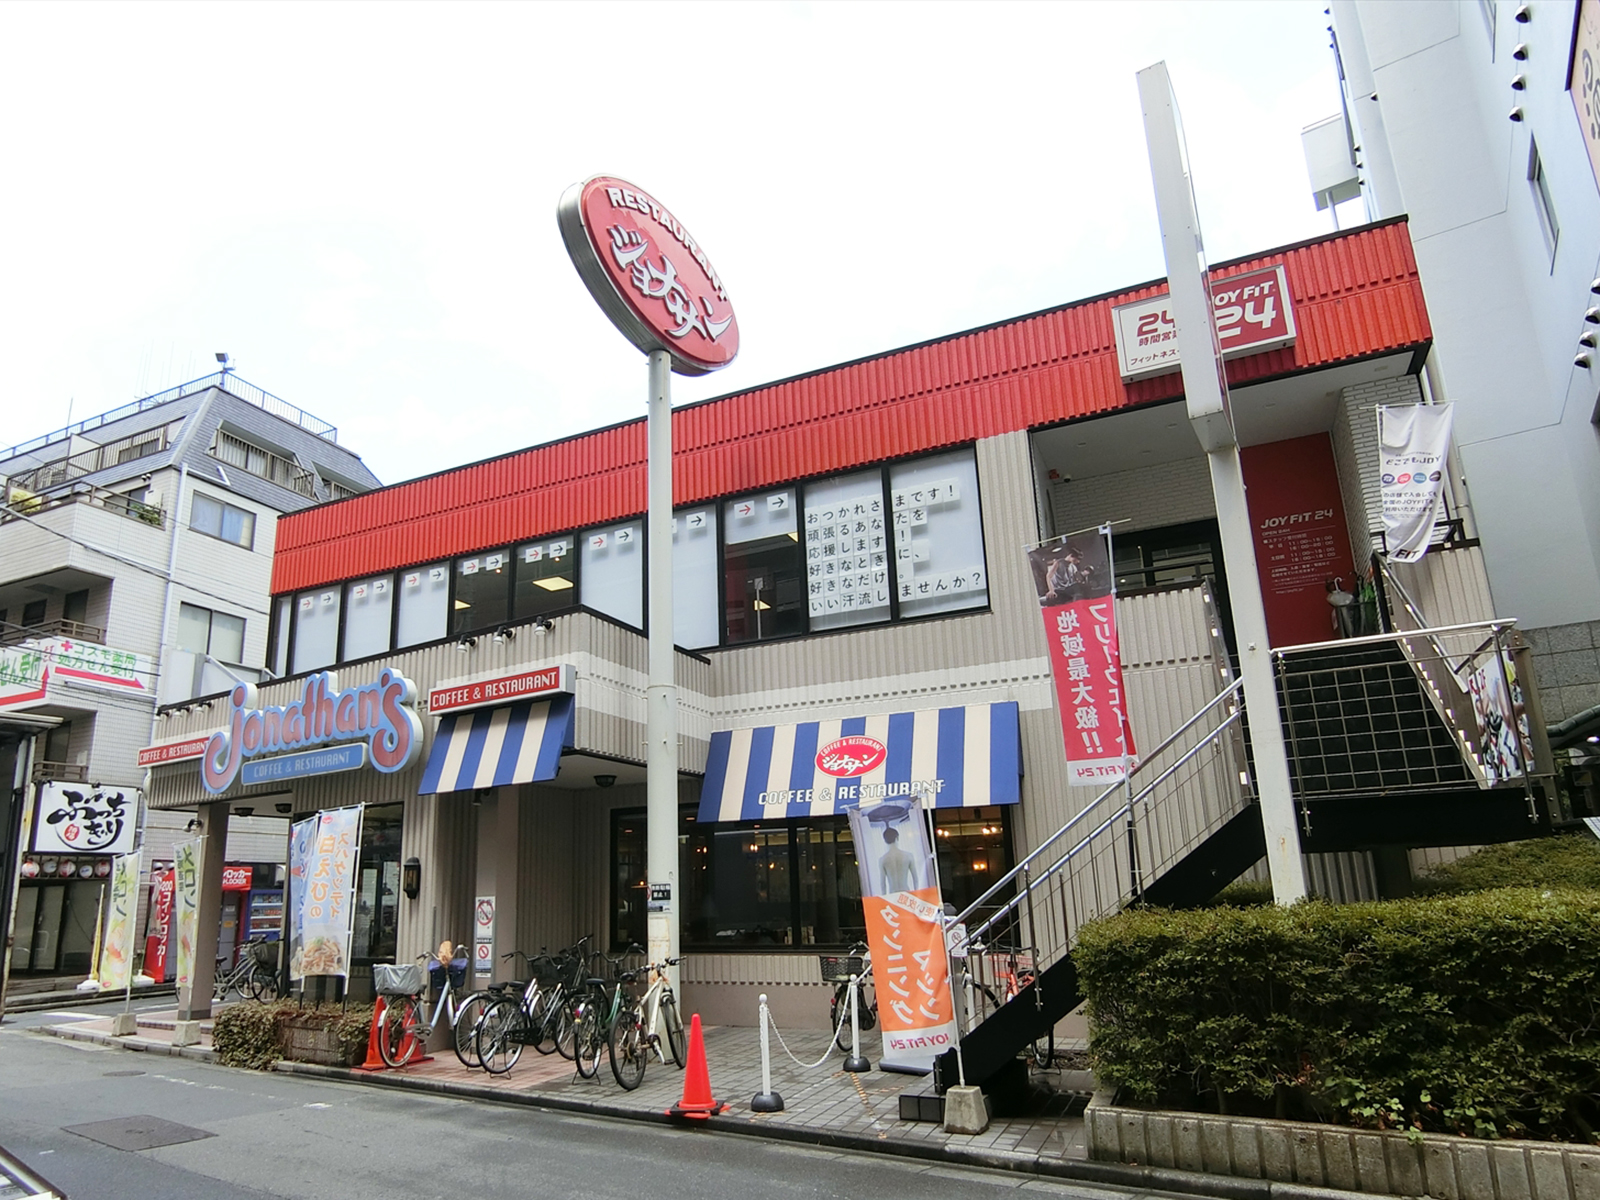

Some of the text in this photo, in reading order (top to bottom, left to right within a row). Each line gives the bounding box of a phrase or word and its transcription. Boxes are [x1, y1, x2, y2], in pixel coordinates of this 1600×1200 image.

[606, 187, 729, 302] RESTAURANT
[1212, 280, 1274, 306] OY FIT
[1215, 296, 1277, 339] 24
[1130, 349, 1180, 366] フィットネス
[1261, 509, 1333, 529] JOY FIT 24
[1395, 549, 1420, 560] FIT
[58, 654, 134, 679] 処方せん受付
[74, 643, 137, 665] コスモ薬局
[432, 672, 556, 707] COFFEE & RESTAURANT
[140, 750, 161, 763] COFFEE
[161, 749, 167, 759] &
[820, 741, 841, 756] COFFEE
[848, 738, 883, 752] RESTAURANT
[254, 751, 350, 778] COFFEE & RESTAURANT
[758, 779, 945, 806] COFFEE & RESTAURANT
[157, 891, 172, 967] コインロッカー
